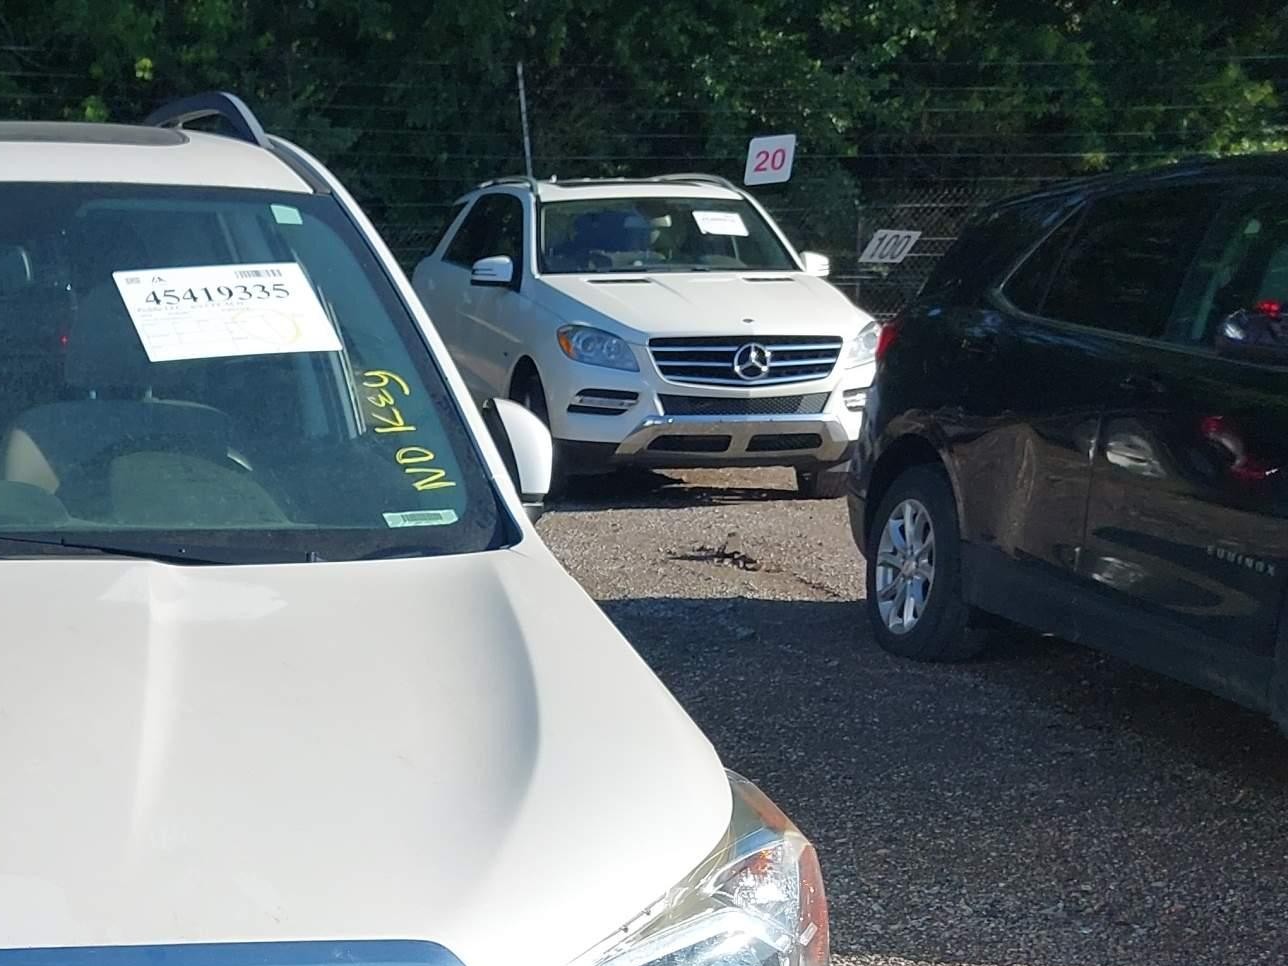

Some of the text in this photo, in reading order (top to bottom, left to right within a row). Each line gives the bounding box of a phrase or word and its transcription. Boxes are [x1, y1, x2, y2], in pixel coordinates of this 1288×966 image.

[753, 148, 786, 172] 20
[869, 232, 912, 260] 100
[145, 283, 290, 306] 45419335
